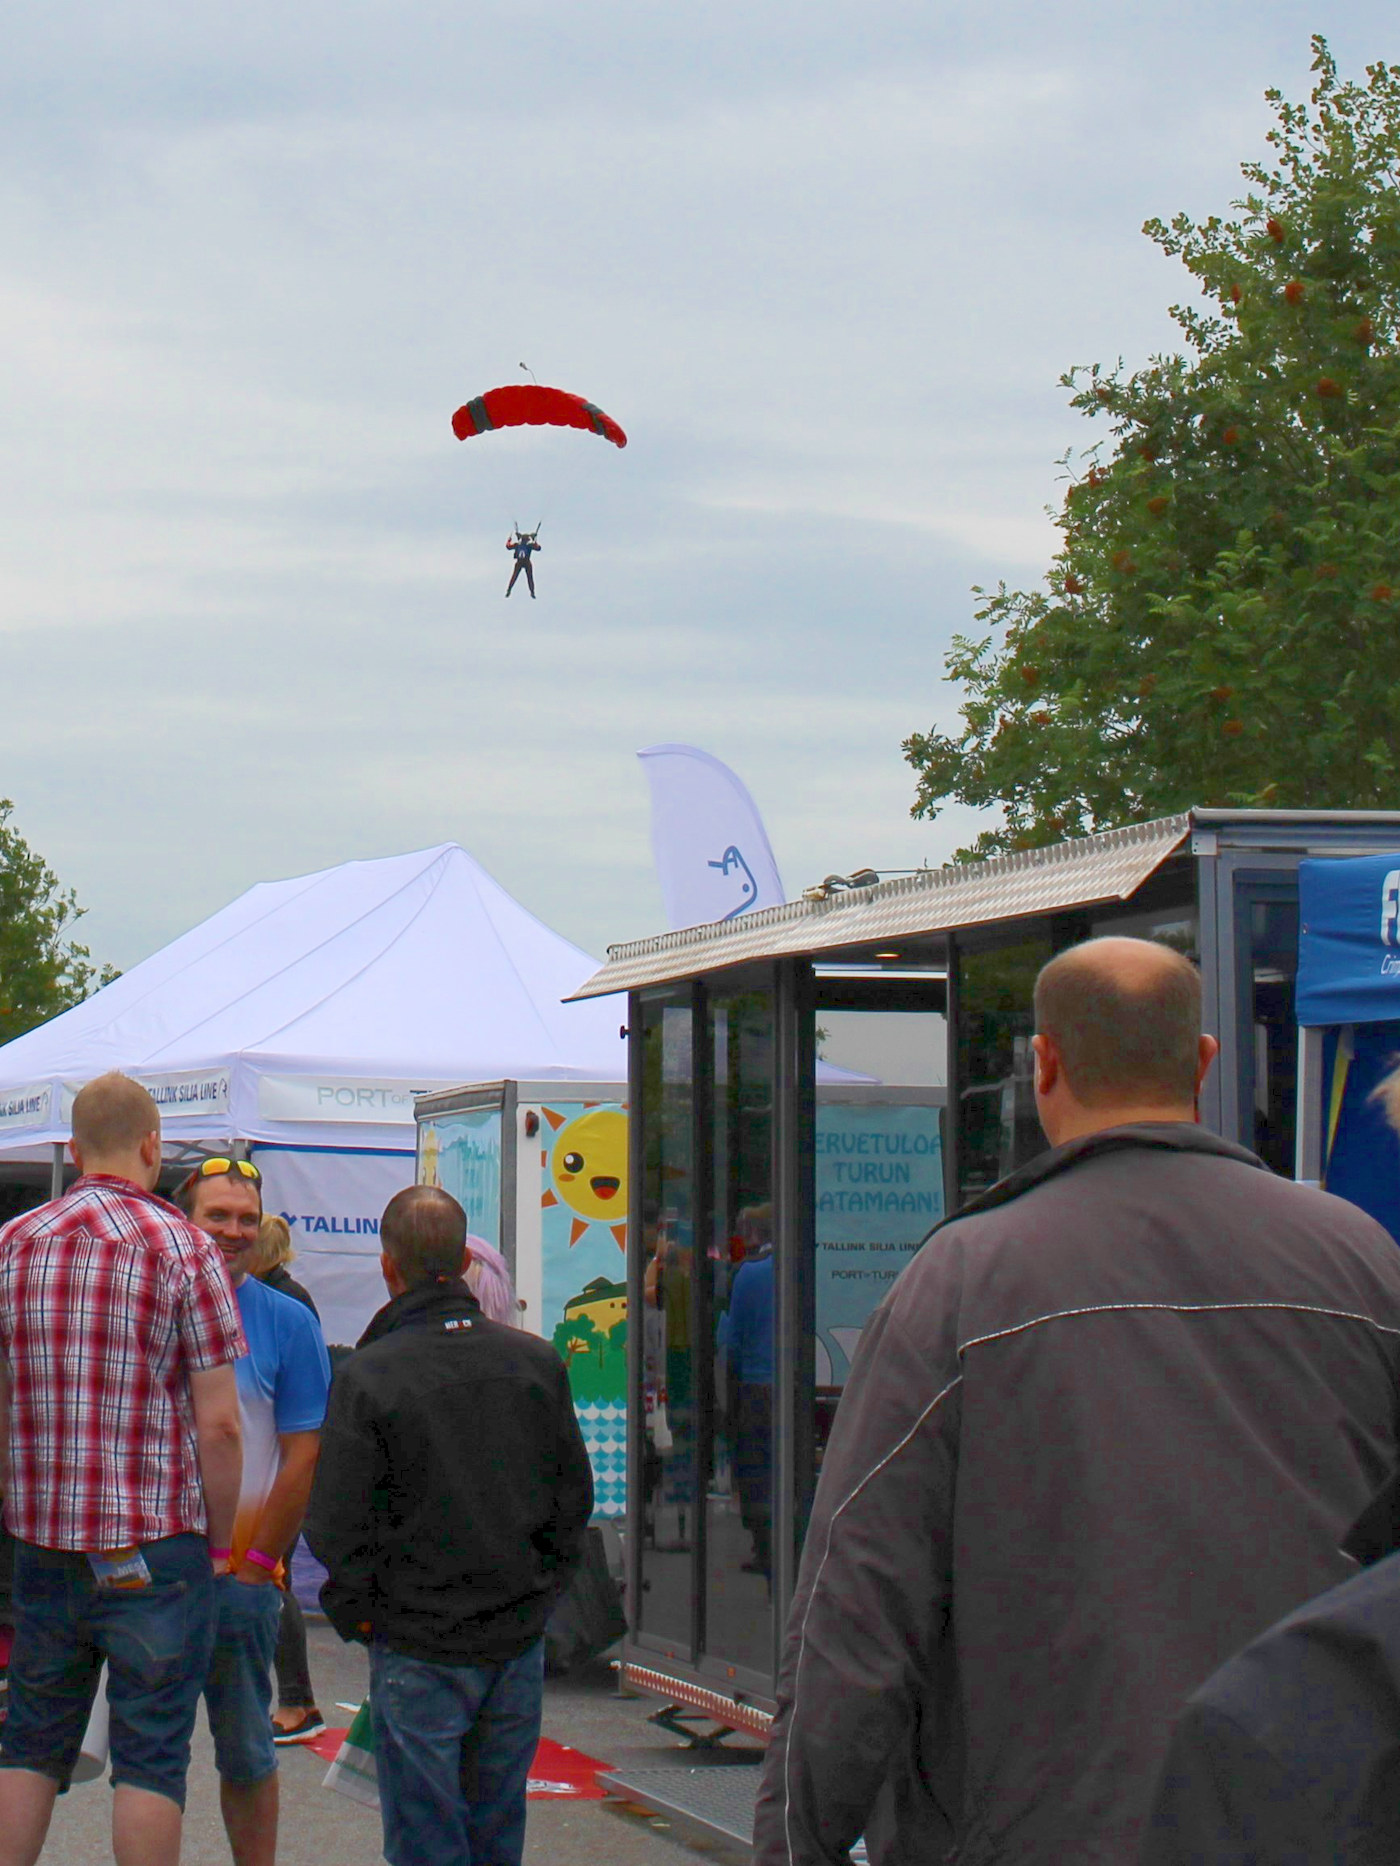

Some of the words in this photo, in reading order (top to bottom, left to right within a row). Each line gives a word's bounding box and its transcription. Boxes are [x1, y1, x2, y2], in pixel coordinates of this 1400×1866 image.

[200, 1081, 218, 1100] LINE
[316, 1086, 392, 1107] PORT
[816, 1132, 941, 1155] ERVETULOA
[832, 1161, 911, 1183] TURUN
[817, 1191, 940, 1213] ATAMAAN!
[301, 1215, 379, 1234] TALLIN
[823, 1242, 865, 1251] TALLINK
[831, 1270, 863, 1280] PORT
[872, 1270, 899, 1280] TUR
